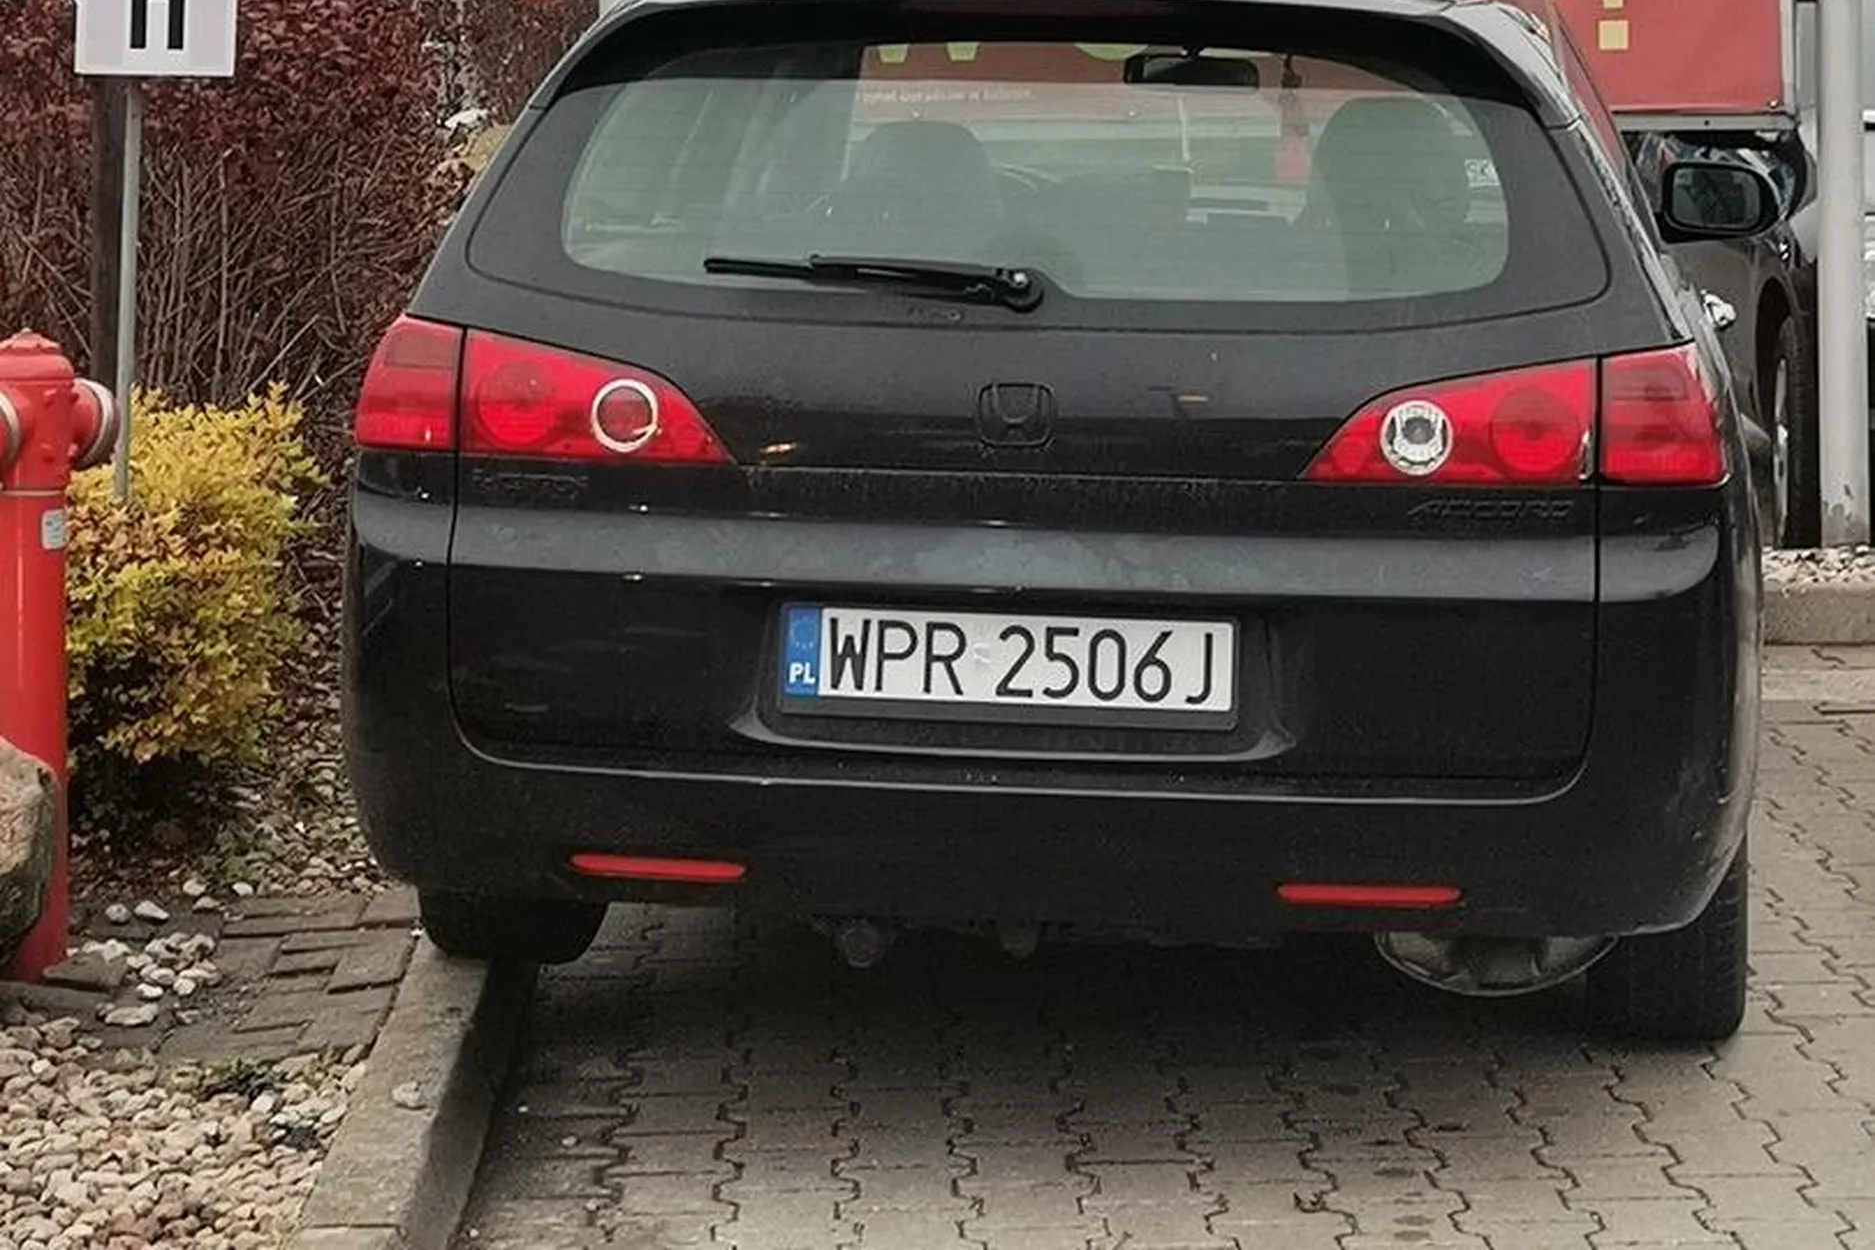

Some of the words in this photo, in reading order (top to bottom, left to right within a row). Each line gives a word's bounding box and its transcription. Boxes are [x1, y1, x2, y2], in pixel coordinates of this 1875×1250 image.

[789, 662, 816, 685] PL
[829, 617, 967, 696] WPR
[995, 624, 1214, 706] 2506J
